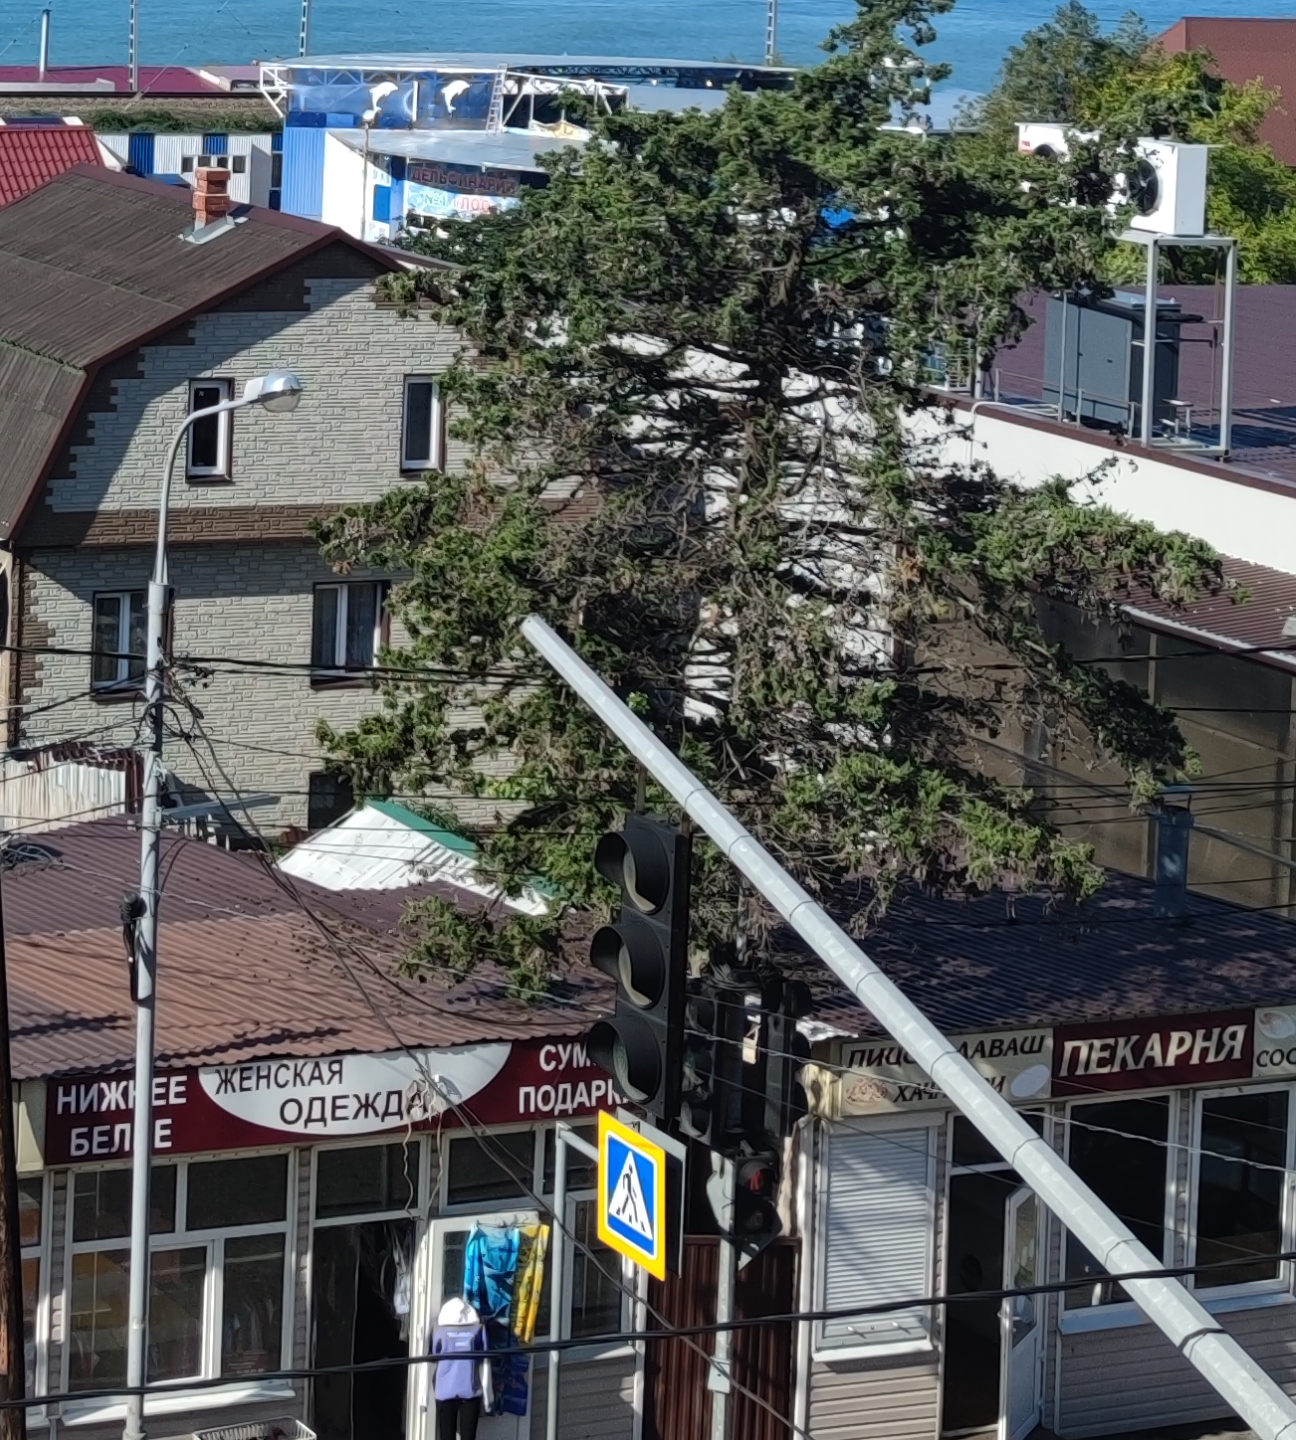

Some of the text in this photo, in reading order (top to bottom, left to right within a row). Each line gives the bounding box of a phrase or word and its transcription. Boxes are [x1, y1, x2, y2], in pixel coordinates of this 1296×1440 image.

[538, 1041, 598, 1072] СУМ
[1058, 1023, 1249, 1078] ПЕКАРНЯ
[215, 1059, 345, 1095] ЖЕНСКАЯ
[518, 1077, 630, 1117] ПОДАРК
[70, 1118, 173, 1157] БЕЛЕ
